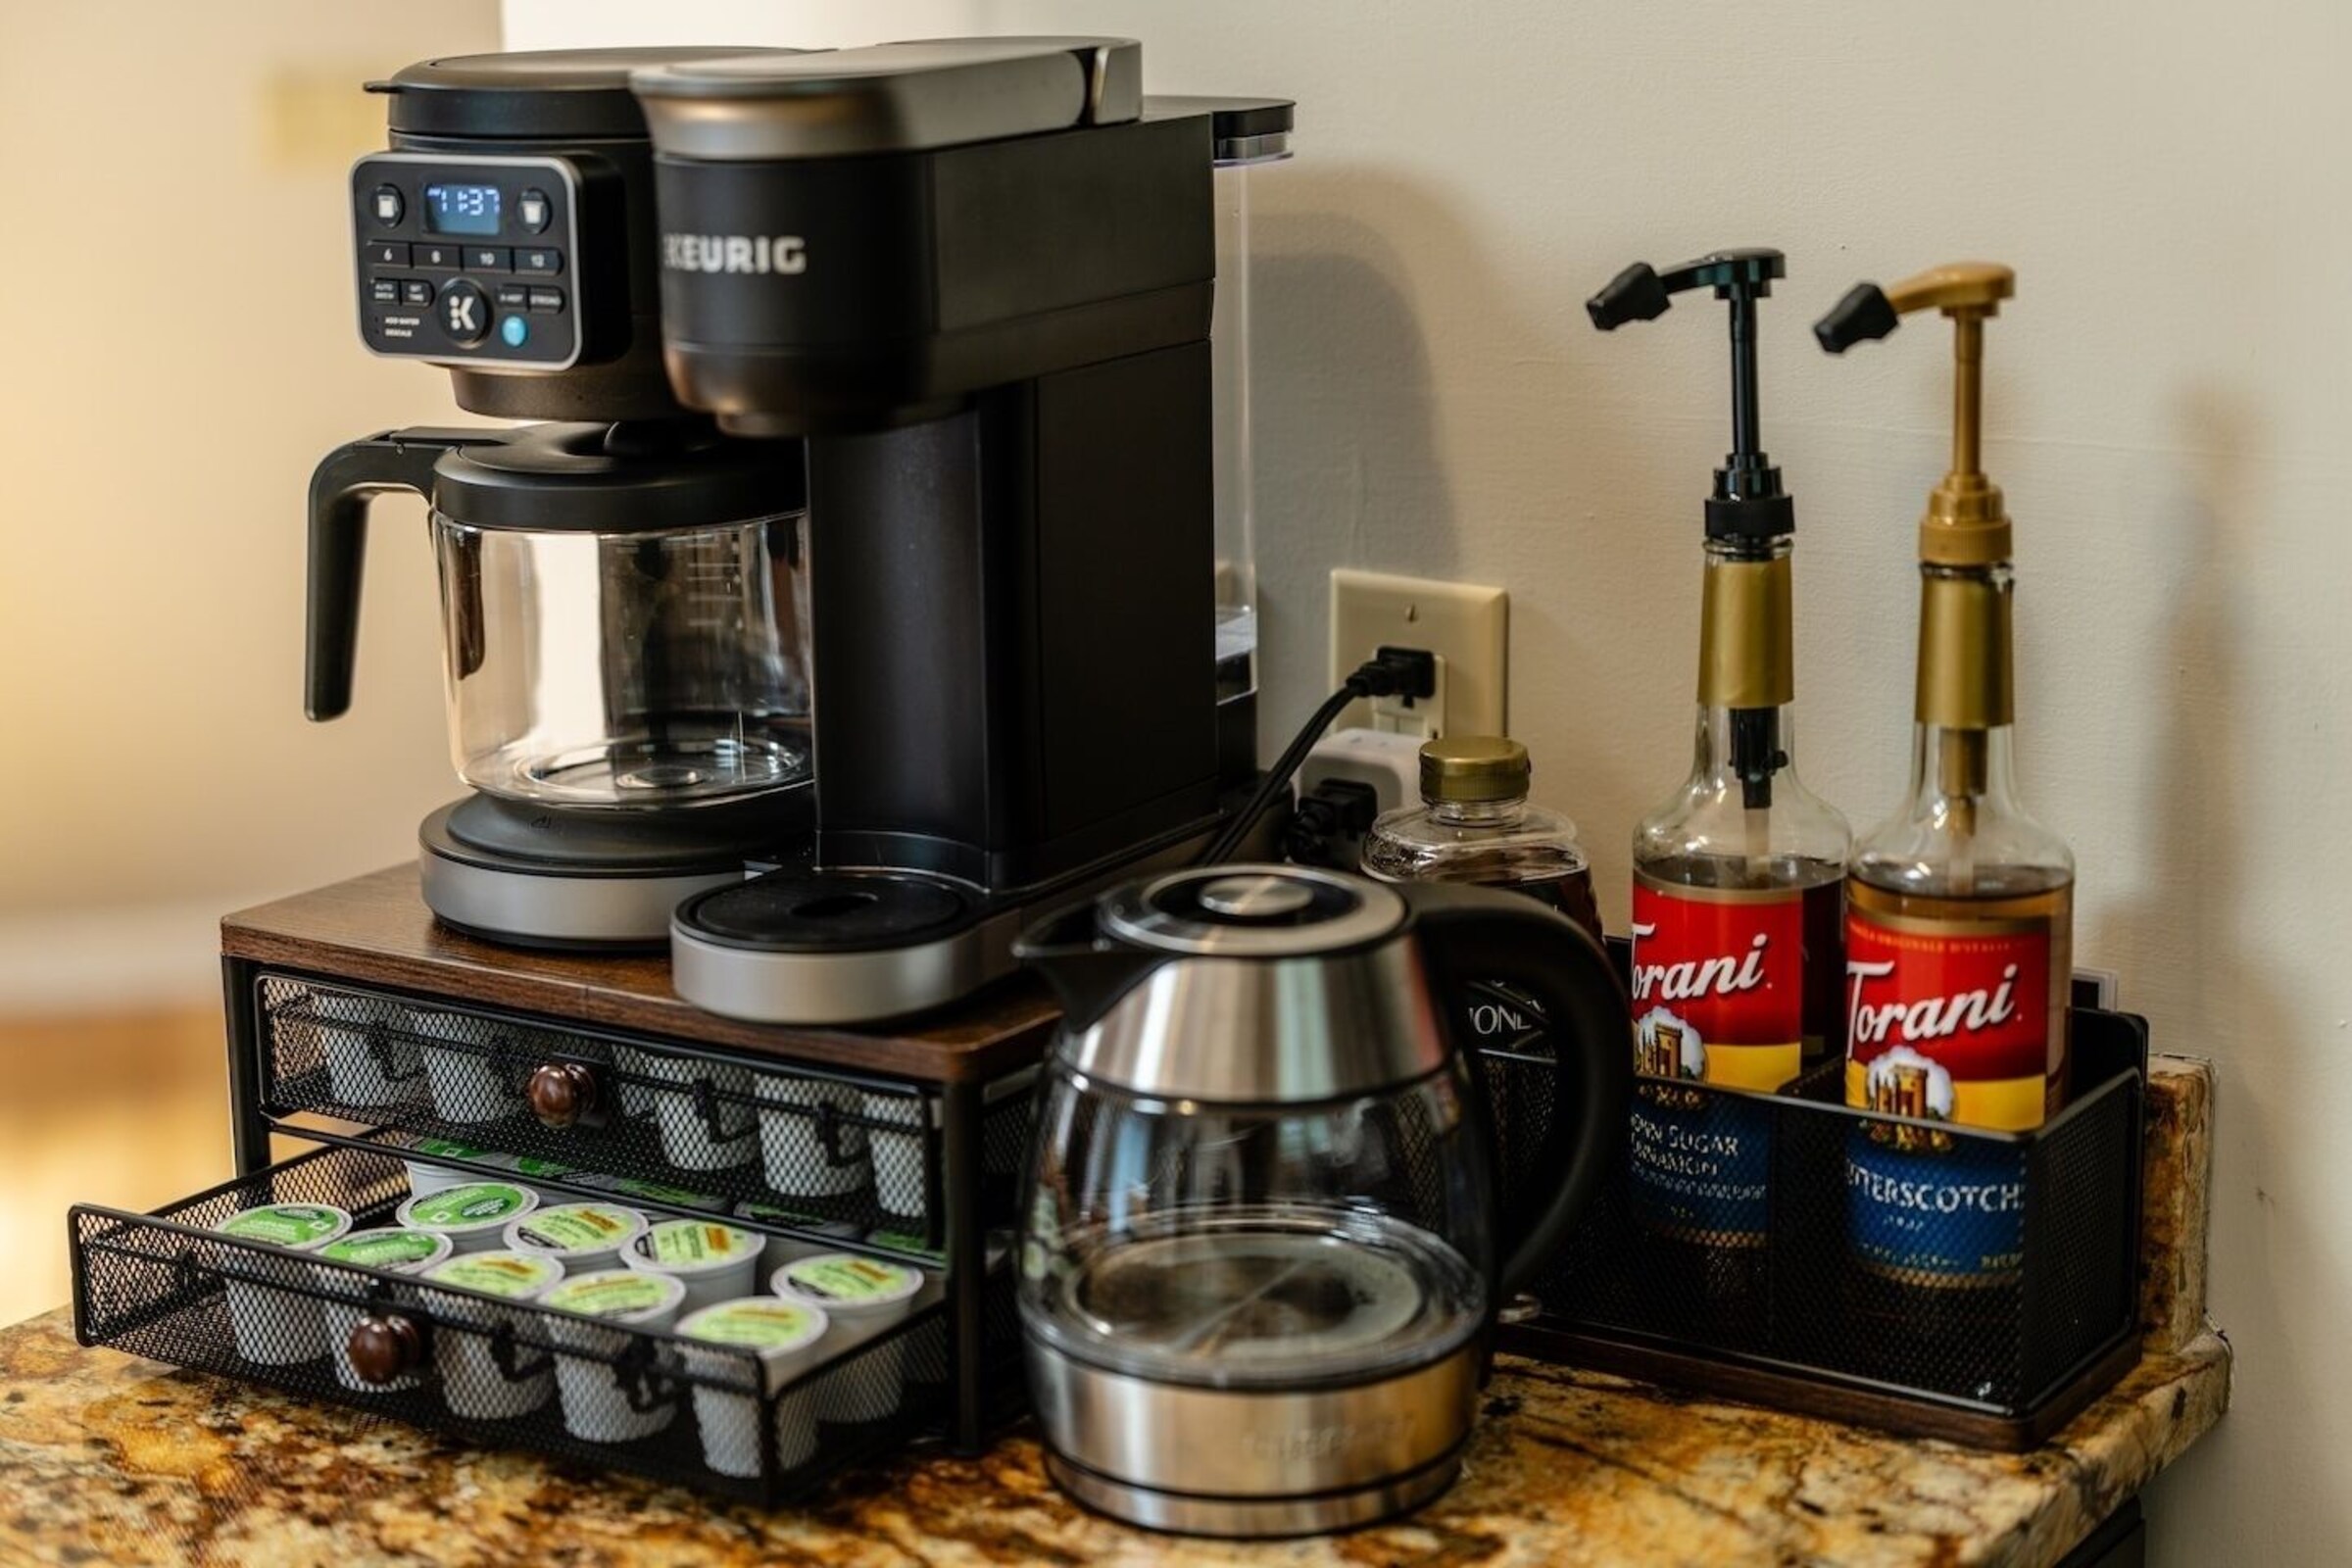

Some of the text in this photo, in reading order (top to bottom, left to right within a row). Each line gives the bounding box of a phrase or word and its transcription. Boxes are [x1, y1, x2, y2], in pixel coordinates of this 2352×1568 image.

[383, 248, 393, 262] 6
[431, 250, 441, 264] 8
[480, 252, 495, 266] 10
[662, 233, 807, 274] KEURIG
[1845, 960, 2019, 1058] Torani
[1668, 1124, 1740, 1156] SUGAR
